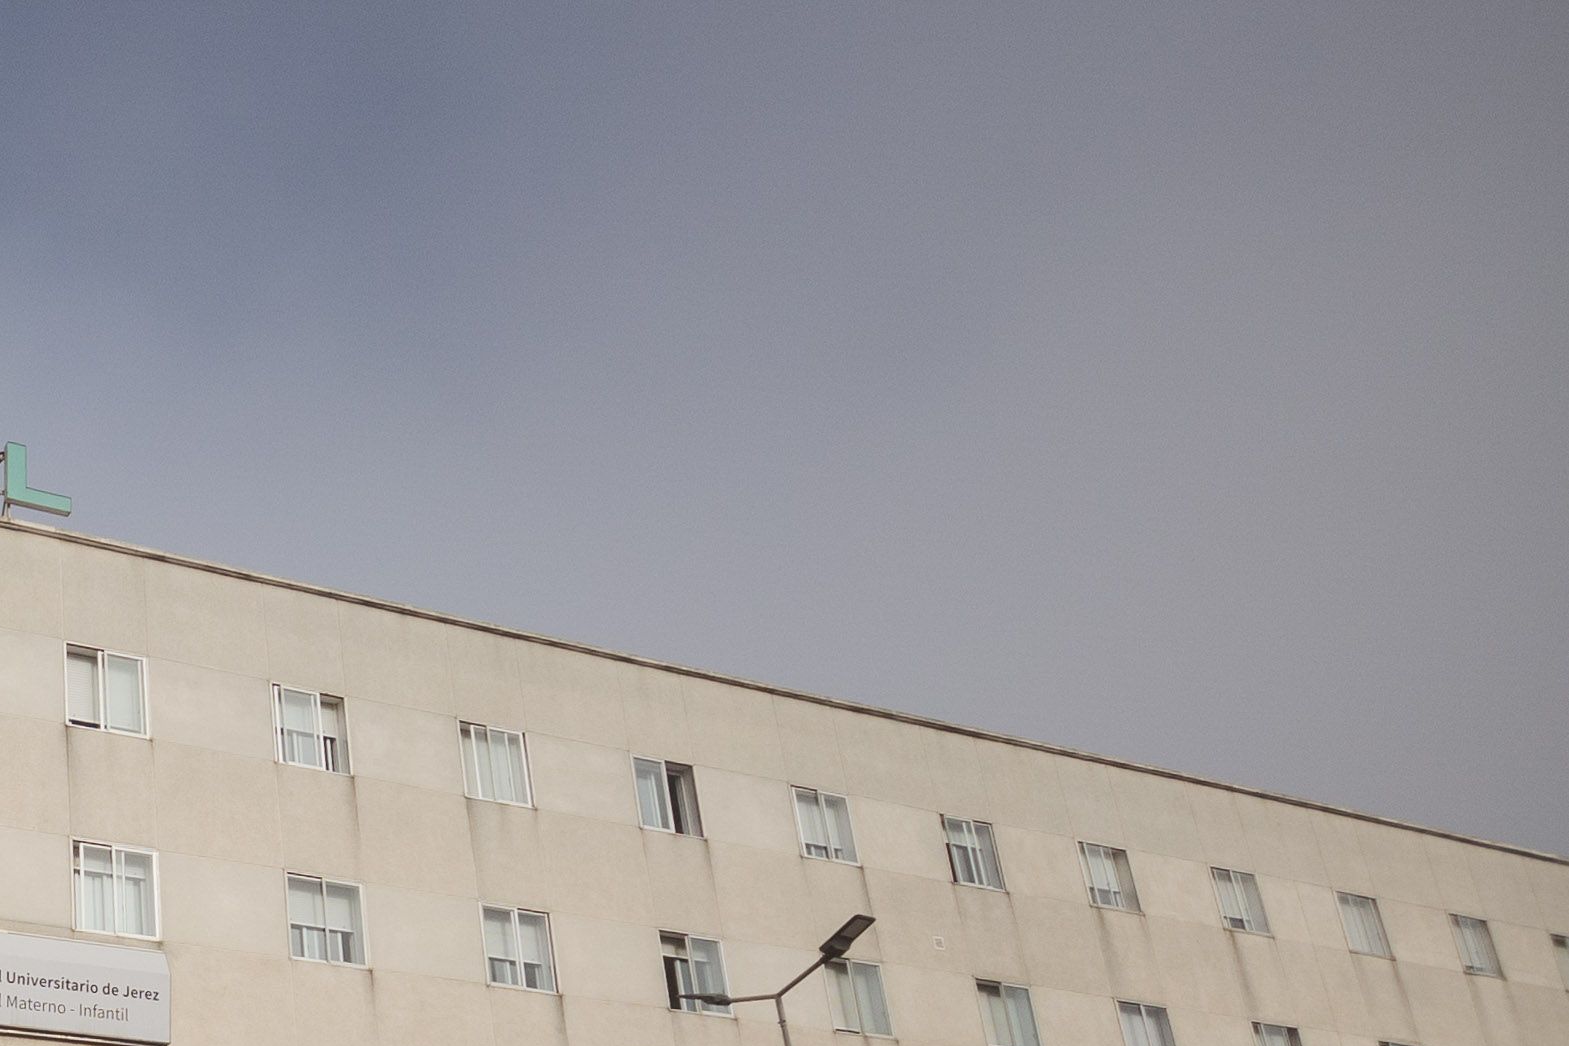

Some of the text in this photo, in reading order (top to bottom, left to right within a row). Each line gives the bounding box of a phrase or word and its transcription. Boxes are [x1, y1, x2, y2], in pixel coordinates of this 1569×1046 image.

[6, 971, 98, 994] Universitario
[102, 982, 119, 996] de
[123, 985, 160, 1001] Jerez
[6, 995, 66, 1014] Materno
[79, 1003, 129, 1022] Infantil
